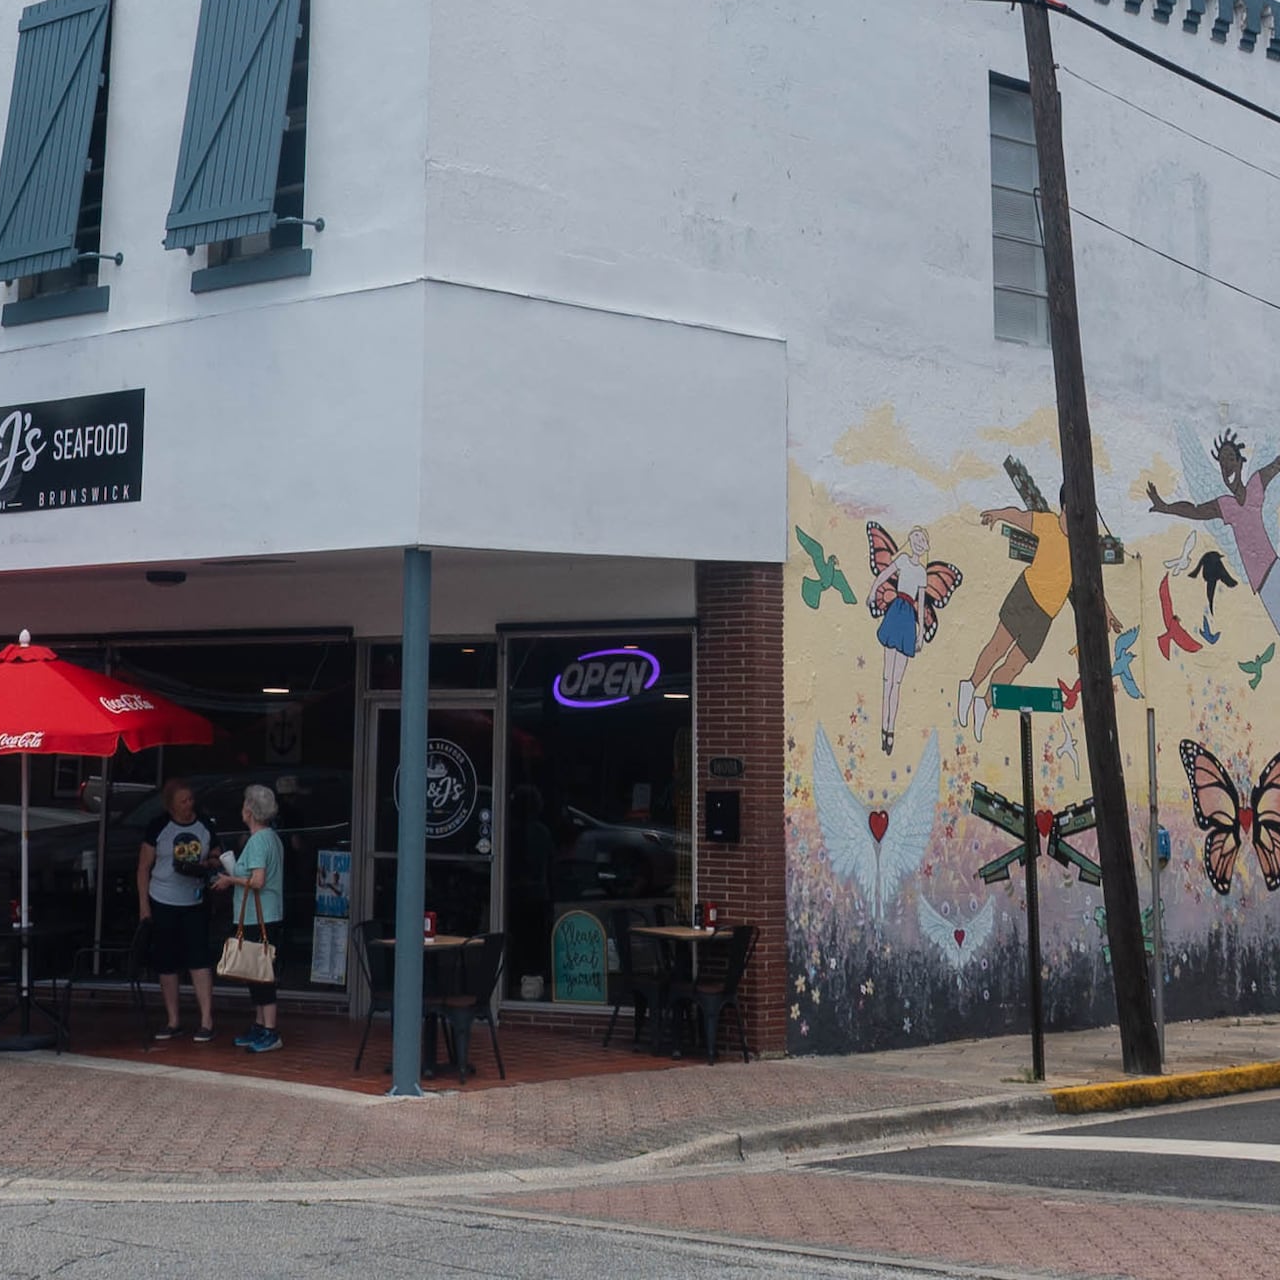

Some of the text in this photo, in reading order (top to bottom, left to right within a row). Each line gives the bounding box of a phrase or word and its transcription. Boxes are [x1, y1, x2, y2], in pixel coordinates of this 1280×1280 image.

[53, 423, 128, 460] SEAFOOD
[39, 484, 131, 507] BRUNSWICK
[560, 661, 648, 696] OPEN
[426, 776, 465, 808] &J's
